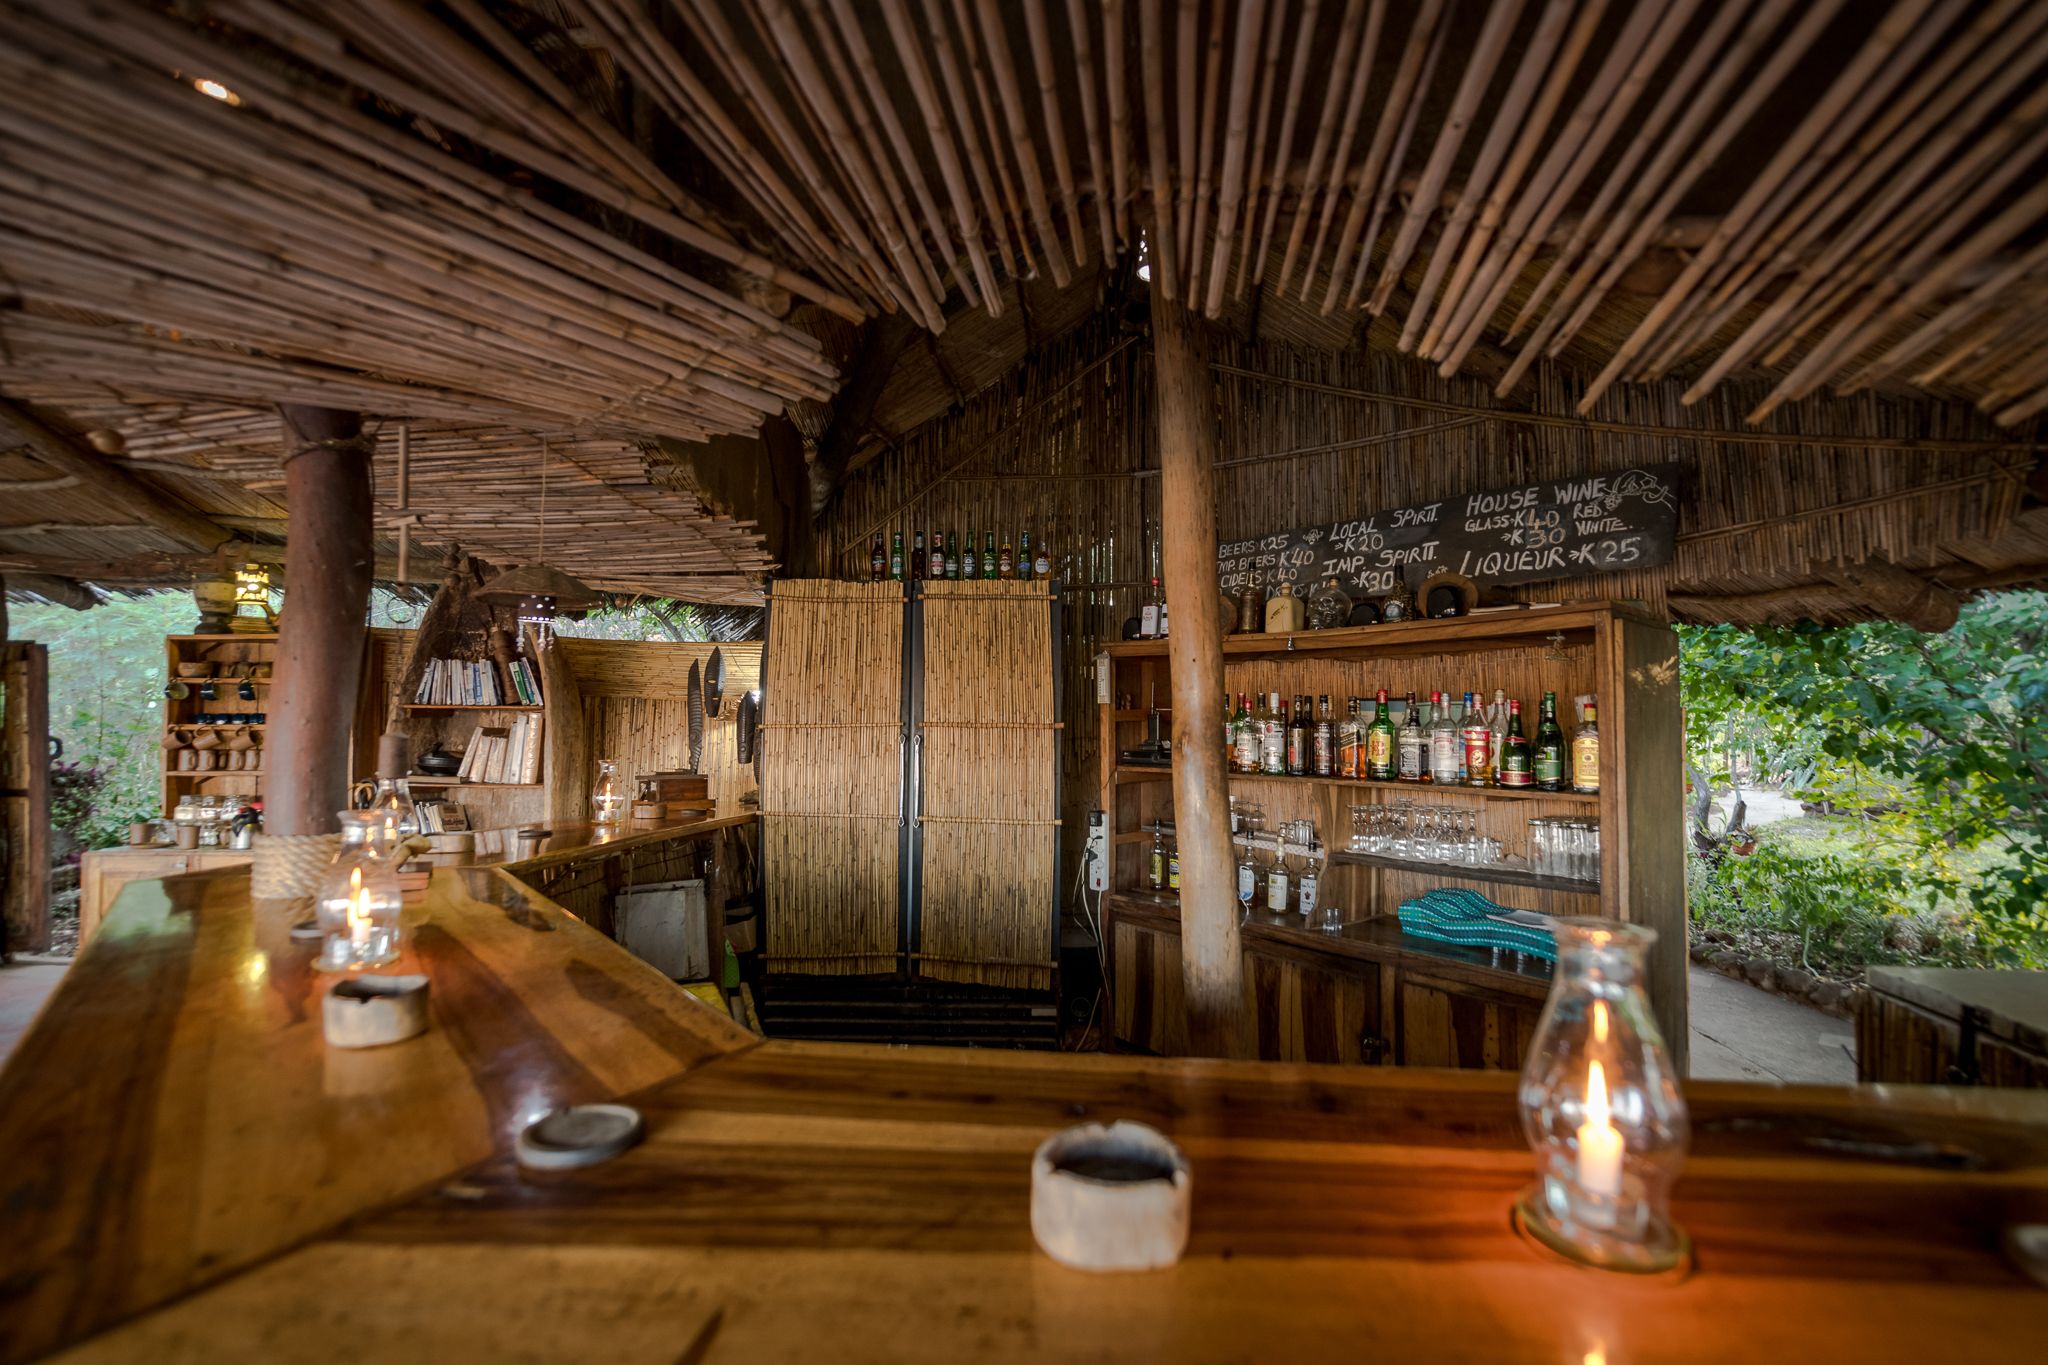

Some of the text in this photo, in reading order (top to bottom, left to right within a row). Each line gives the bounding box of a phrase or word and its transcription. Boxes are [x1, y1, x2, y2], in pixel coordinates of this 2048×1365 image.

[1466, 477, 1607, 517] HOUSE WINE
[1329, 517, 1378, 542] LOCAL
[1464, 514, 1511, 533] GLASS
[1218, 534, 1290, 559] BEERS K25
[1343, 533, 1384, 553] K20
[1510, 528, 1566, 549] K30
[1278, 547, 1315, 567] K40
[1321, 556, 1366, 577] IMP.
[1459, 536, 1642, 578] LIQUEUR K25
[1266, 568, 1298, 582] K40
[1358, 570, 1394, 593] K30
